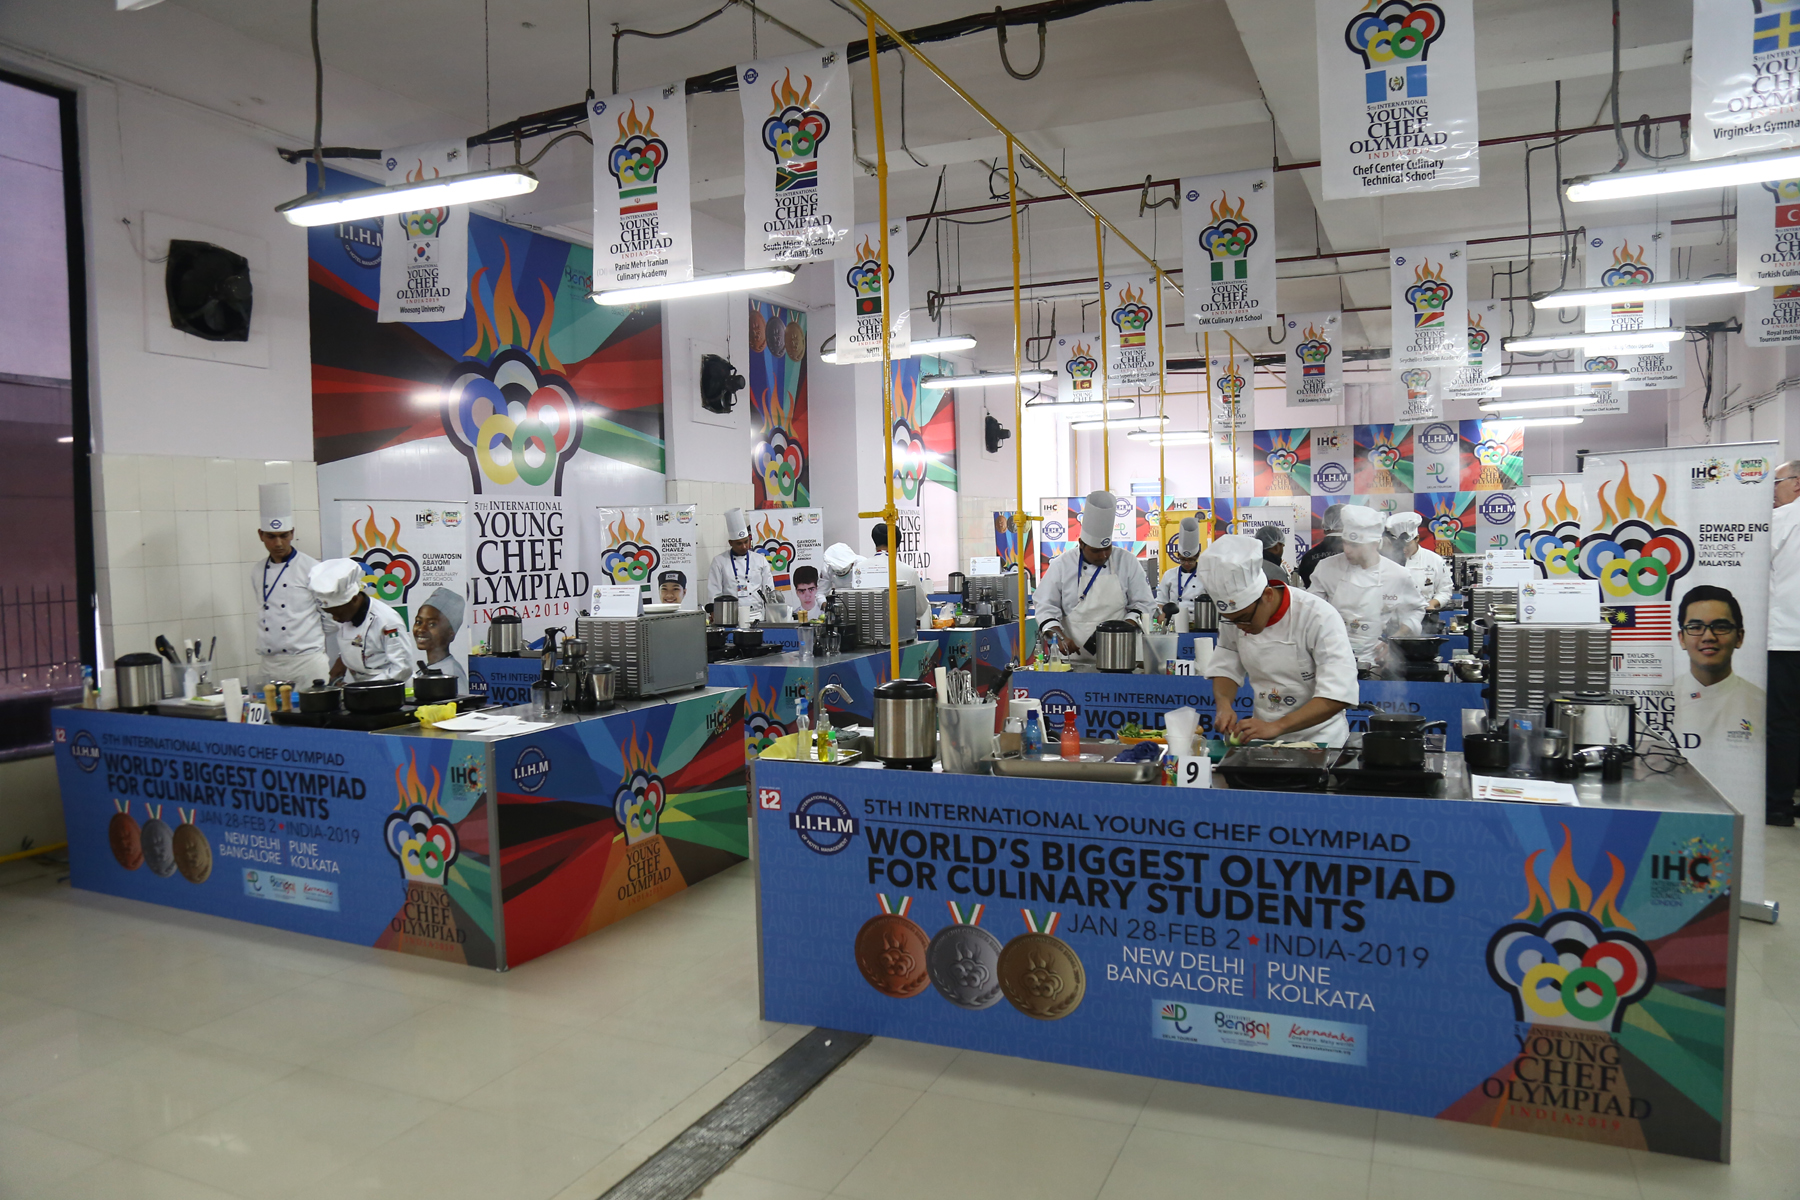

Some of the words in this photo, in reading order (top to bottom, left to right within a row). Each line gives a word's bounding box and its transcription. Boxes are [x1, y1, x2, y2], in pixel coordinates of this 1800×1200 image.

[1377, 99, 1427, 110] INTERNATIONAL
[1366, 105, 1429, 123] YOUNG
[1367, 117, 1428, 139] CHEF
[1713, 123, 1761, 140] Virginska
[1349, 132, 1448, 154] OLYMPIAD
[1352, 164, 1373, 176] Chef
[1375, 161, 1405, 174] Center
[1406, 158, 1444, 170] Culinary
[1362, 174, 1403, 186] Technical
[1405, 170, 1436, 182] School
[775, 193, 818, 208] YOUNG
[775, 203, 818, 221] CHEF
[620, 216, 659, 230] YOUNG
[763, 214, 833, 232] OLYMPIAD
[620, 226, 659, 243] CHEF
[610, 237, 673, 255] OLYMPIAD
[407, 268, 439, 279] YOUNG
[615, 262, 630, 271] Paniz
[630, 260, 646, 269] Mehr
[647, 258, 669, 268] Iranian
[616, 272, 640, 282] Culinary
[641, 270, 667, 280] Academy
[1758, 269, 1781, 279] Turkish
[407, 277, 439, 290] CHEF
[1211, 284, 1248, 293] YOUNG
[396, 287, 451, 300] OLYMPIAD
[1211, 291, 1248, 303] CHEF
[400, 306, 421, 314] Woosong
[421, 305, 446, 314] University
[1201, 299, 1259, 312] OLYMPIAD
[1212, 316, 1234, 326] Culinary
[1244, 314, 1262, 323] School
[1611, 317, 1643, 325] YOUNG
[1406, 343, 1454, 352] OLYMPIAD
[1415, 337, 1445, 346] CHEF
[1112, 361, 1155, 370] OLYMPIAD
[1630, 366, 1673, 374] OLYMPIAD
[1317, 436, 1338, 446] IHC
[1691, 467, 1717, 478] IHC
[489, 501, 562, 511] INTERNATIONAL
[1483, 503, 1516, 513] I.I.H.M
[416, 514, 432, 523] IHC
[474, 512, 564, 538] YOUNG
[1699, 523, 1745, 533] EDWARD
[1748, 523, 1769, 532] ENG
[1699, 533, 1734, 542] SHENG
[1737, 533, 1753, 542] PEI
[476, 538, 563, 575] CHEF
[491, 672, 507, 681] 5TH
[1178, 664, 1190, 675] 11
[785, 686, 806, 698] IHC
[1085, 692, 1110, 703] 5TH
[250, 707, 262, 722] 10
[55, 728, 66, 742] t2
[72, 745, 100, 758] I.I.H.M
[102, 734, 120, 745] 5TH
[122, 736, 203, 754] INTERNATIONAL
[205, 743, 245, 757] YOUNG
[248, 746, 279, 760] CHEF
[282, 749, 345, 766] OLYMPIAD
[104, 753, 178, 780] WORLD'S
[183, 761, 257, 788] BIGGEST
[261, 769, 366, 800] OLYMPIAD
[451, 766, 479, 787] IHC
[514, 760, 549, 780] I.I.H.M
[1186, 762, 1199, 783] 9
[107, 776, 140, 796] FOR
[142, 779, 227, 807] CULINARY
[232, 789, 330, 820] STUDENTS
[760, 790, 781, 810] t2
[829, 797, 848, 816] INSTITUTE
[199, 810, 222, 826] JAN
[225, 813, 266, 832] 28-FEB
[269, 819, 277, 834] 2
[286, 822, 360, 844] INDIA-2019
[795, 815, 854, 834] I.I.H.M
[864, 799, 903, 817] 5TH
[908, 801, 1089, 831] INTERNATIONAL
[1094, 815, 1186, 838] YOUNG
[1193, 821, 1261, 843] CHEF
[1269, 826, 1411, 852] OLYMPIAD
[225, 832, 248, 846] NEW
[250, 835, 281, 851] DELHI
[289, 840, 319, 857] PUNE
[626, 841, 661, 865] YOUNG
[806, 838, 821, 851] HOTEL
[821, 838, 848, 853] MANAGEMENT
[219, 844, 282, 865] BANGALORE
[290, 855, 340, 875] KOLKATA
[864, 826, 1030, 869] WORLD'S
[1042, 842, 1209, 884] BIGGEST
[1219, 855, 1455, 904] OLYMPIAD
[627, 858, 661, 883] CHEF
[1651, 854, 1712, 885] IHC
[617, 866, 672, 902] OLYMPIAD
[403, 887, 451, 908] YOUNG
[868, 857, 937, 891] FOR
[947, 864, 1137, 911] CULINARY
[1146, 882, 1366, 933] STUDENTS
[404, 903, 451, 925] CHEF
[391, 917, 466, 945] OLYMPIAD
[1068, 913, 1118, 938] JAN
[1127, 918, 1217, 948] 28-FEB
[1225, 928, 1241, 950] 2
[1265, 932, 1429, 969] INDIA-2019
[1123, 945, 1174, 968] NEW
[1181, 951, 1245, 975] DELHI
[1267, 961, 1331, 985] PUNE
[1106, 963, 1244, 997] BANGALORE
[1267, 983, 1376, 1013] KOLKATA
[1214, 1011, 1270, 1040] Bengal
[1288, 1023, 1355, 1043] Karnataka
[1177, 1035, 1198, 1043] TOURISM
[1514, 1033, 1621, 1066] YOUNG
[1514, 1056, 1619, 1092] CHEF
[1482, 1078, 1652, 1120] OLYMPIAD
